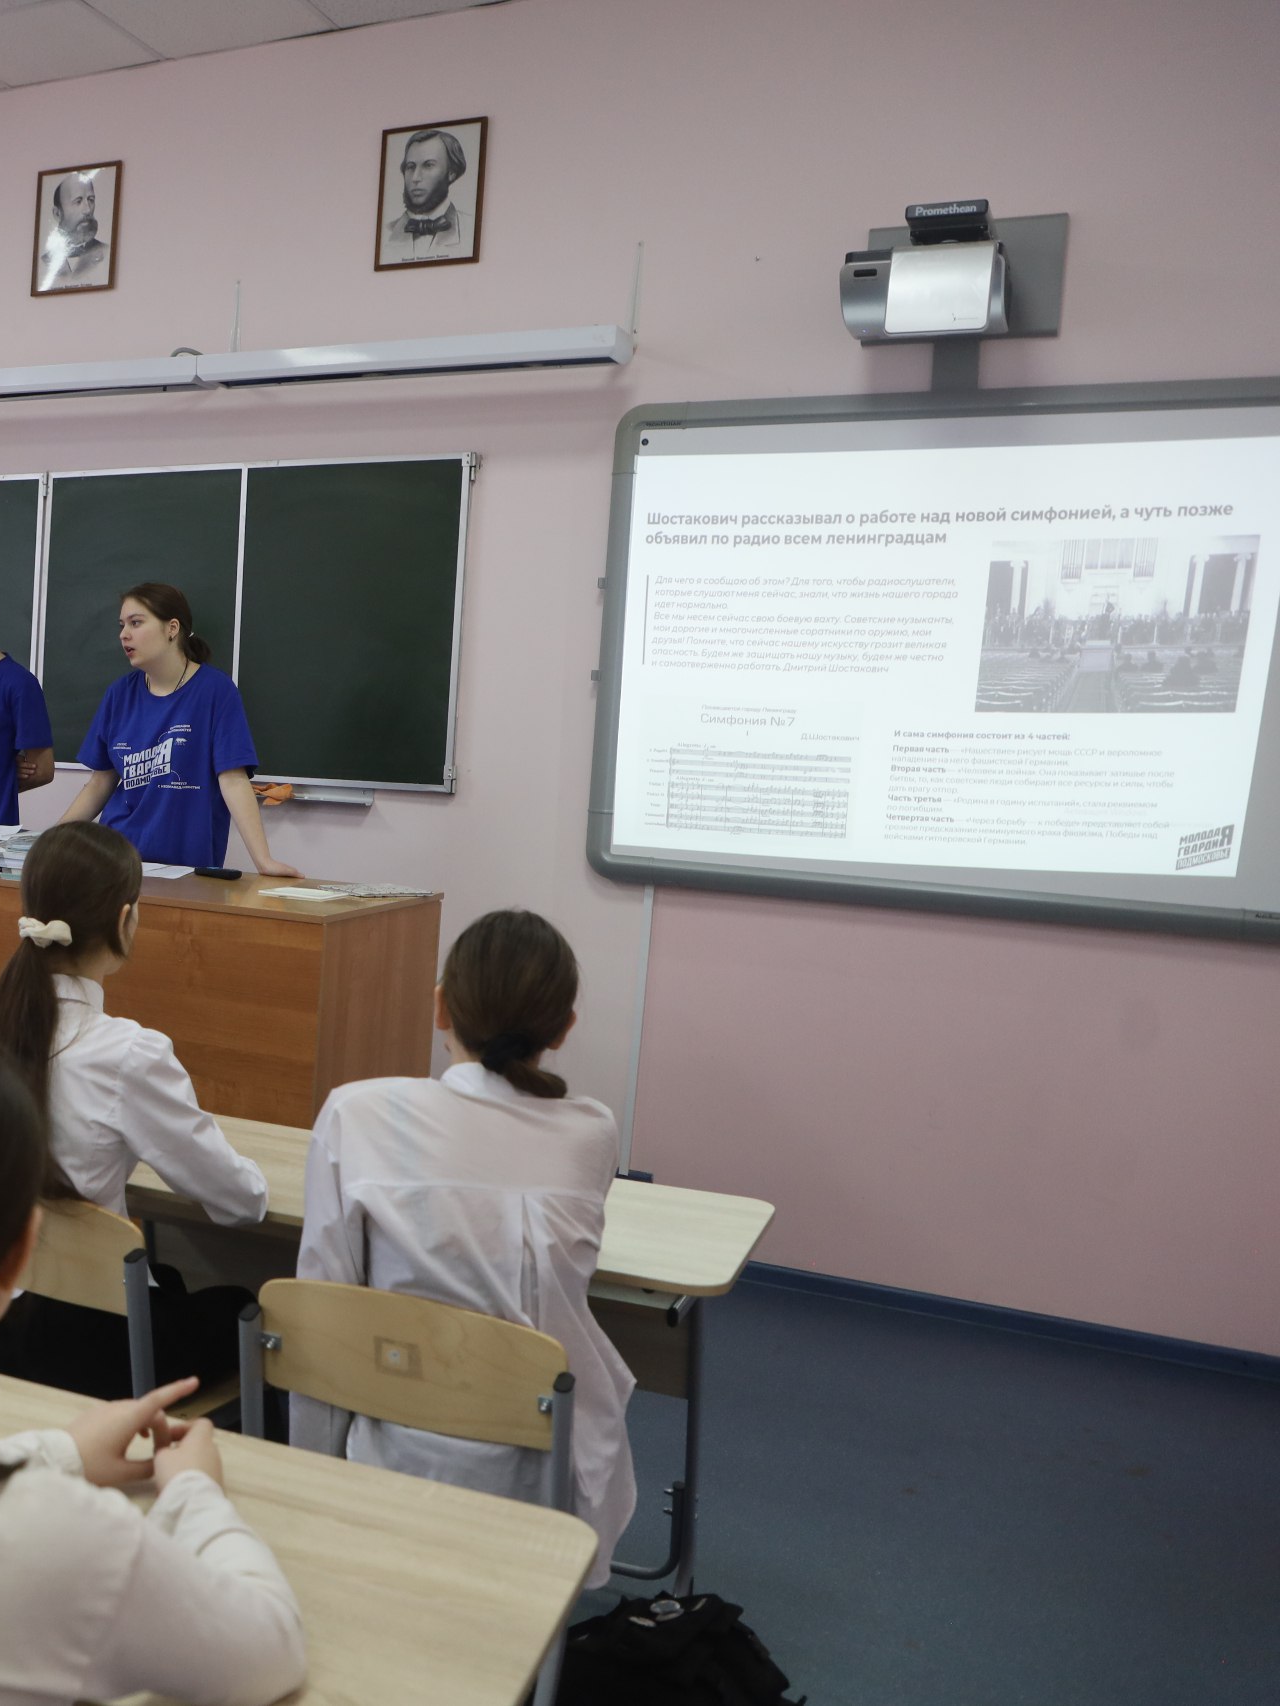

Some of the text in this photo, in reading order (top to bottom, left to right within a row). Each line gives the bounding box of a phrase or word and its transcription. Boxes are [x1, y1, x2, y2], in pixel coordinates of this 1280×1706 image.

[915, 203, 976, 217] Promethean
[647, 503, 1233, 528] Шостакович рассказывал о работе над новой симфонией, а чуть позже
[645, 531, 947, 548] объявил по радио всем ленинградцам
[655, 576, 672, 585] Для
[704, 577, 747, 586] сообщаю
[748, 576, 760, 585] об
[763, 577, 790, 586] этом?
[791, 577, 809, 586] Для
[836, 578, 865, 586] чтобы
[868, 578, 955, 587] радиослушатели,
[655, 590, 692, 598] которые
[694, 590, 736, 598] слушают
[799, 591, 830, 599] знали,
[922, 592, 958, 600] города
[654, 612, 670, 620] Все
[717, 613, 749, 622] сейчас
[777, 614, 812, 624] боевую
[844, 615, 896, 624] Советские
[897, 617, 954, 625] музыканты,
[672, 626, 710, 634] дорогие
[719, 627, 798, 635] многочисленные
[747, 638, 780, 647] сейчас
[781, 640, 819, 648] нашему
[821, 640, 869, 649] искусству
[870, 641, 902, 649] грозит
[905, 641, 947, 649] великая
[701, 650, 733, 658] Будем
[746, 651, 795, 660] защищать
[862, 652, 893, 662] будем
[910, 654, 944, 662] честно
[659, 661, 736, 670] самоотверженно
[783, 663, 826, 672] Дмитрий
[700, 713, 766, 726] Симфония
[927, 731, 974, 740] симфония
[893, 745, 925, 753] Первая
[891, 765, 920, 773] Вторая
[886, 814, 929, 822] Четвертая
